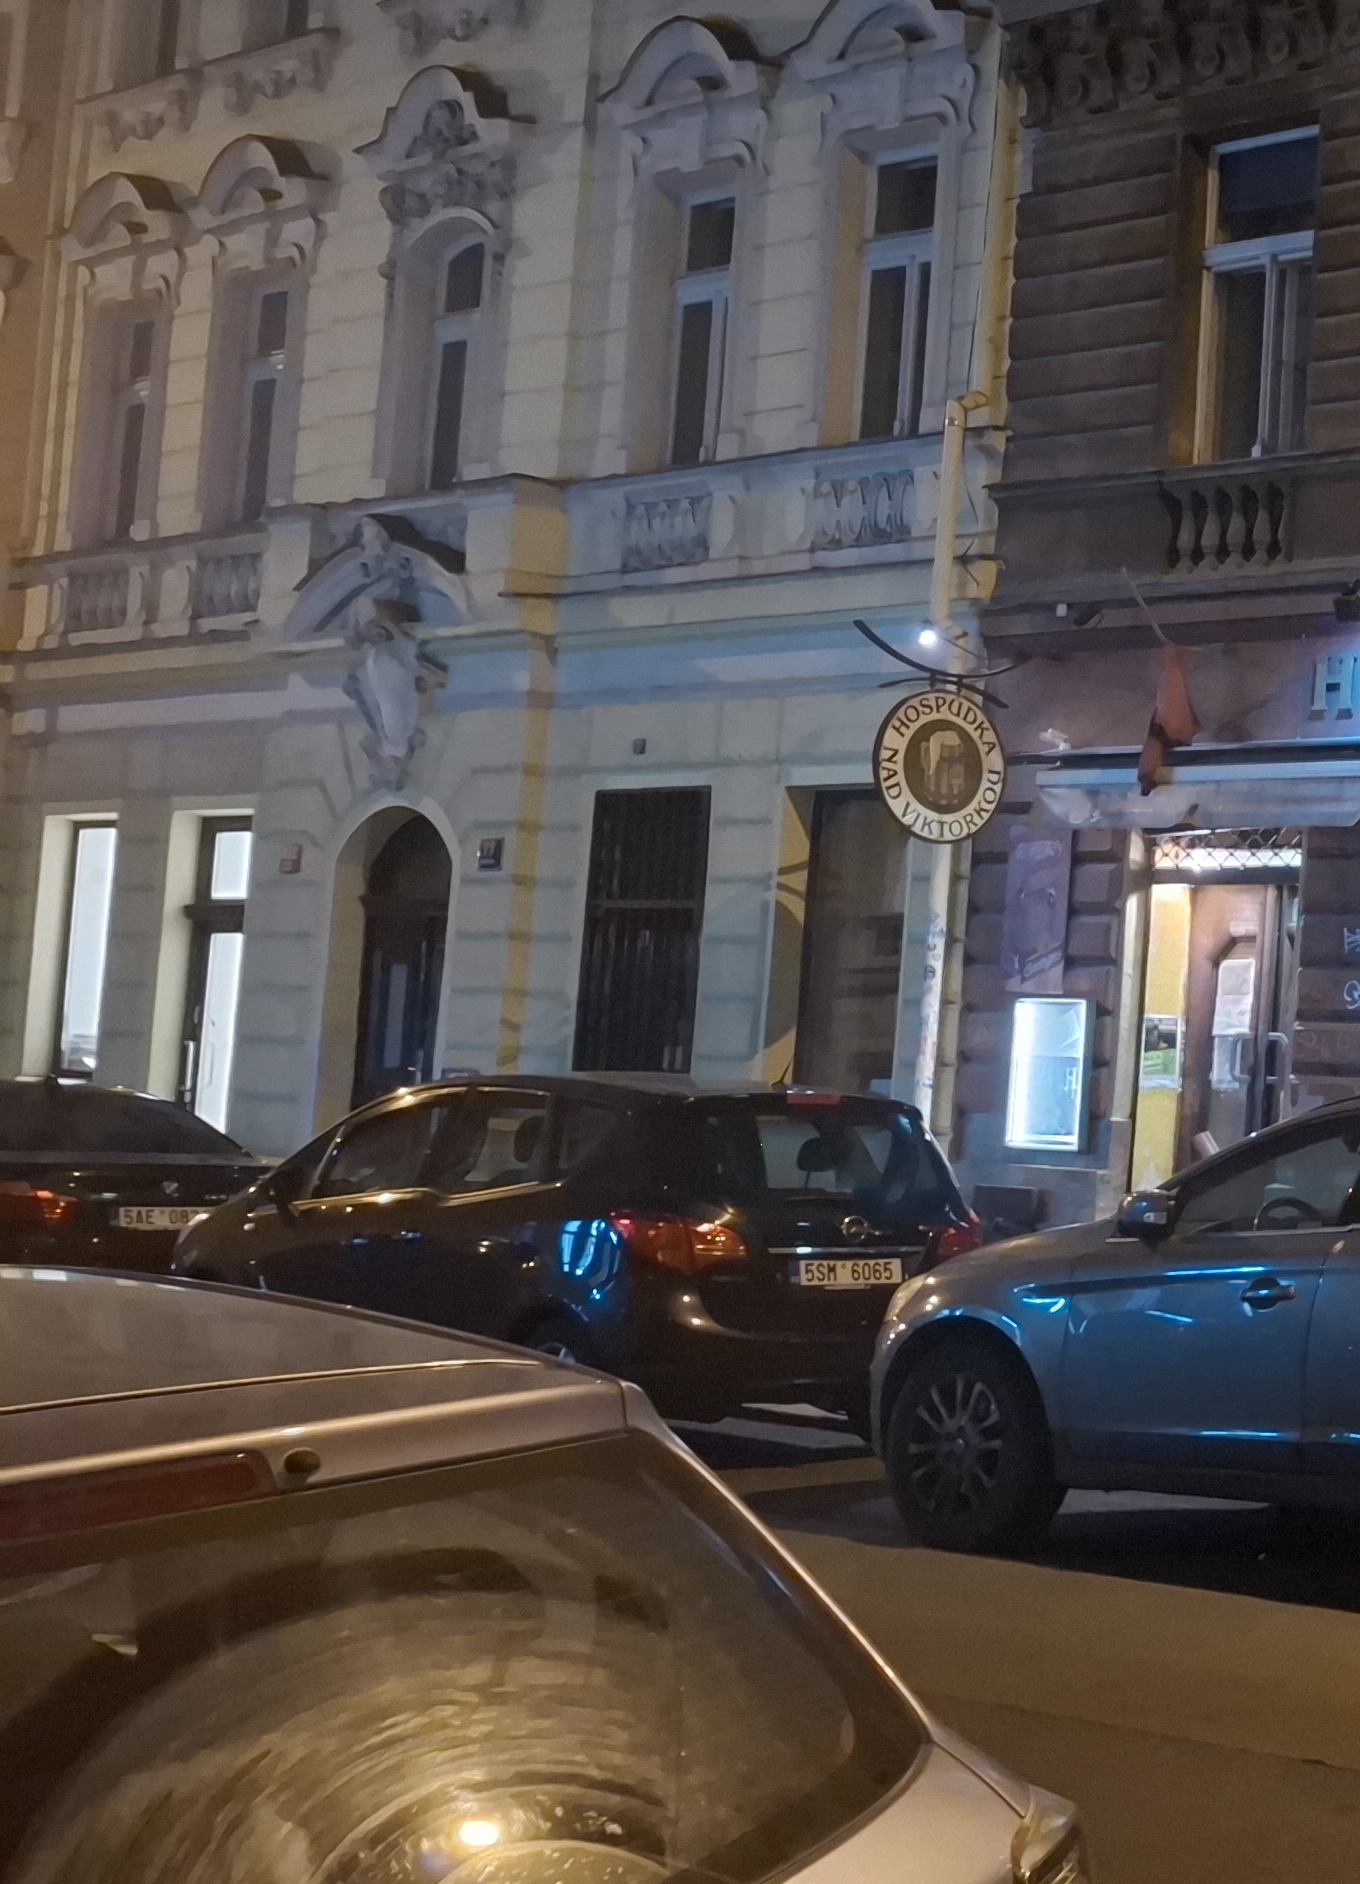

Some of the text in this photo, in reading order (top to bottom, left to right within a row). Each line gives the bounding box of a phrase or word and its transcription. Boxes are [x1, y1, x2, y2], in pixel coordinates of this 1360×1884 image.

[880, 746, 1002, 839] NAD VIKTORKOU
[123, 1208, 155, 1226] 5AE
[804, 1261, 893, 1283] 5SM 6065
